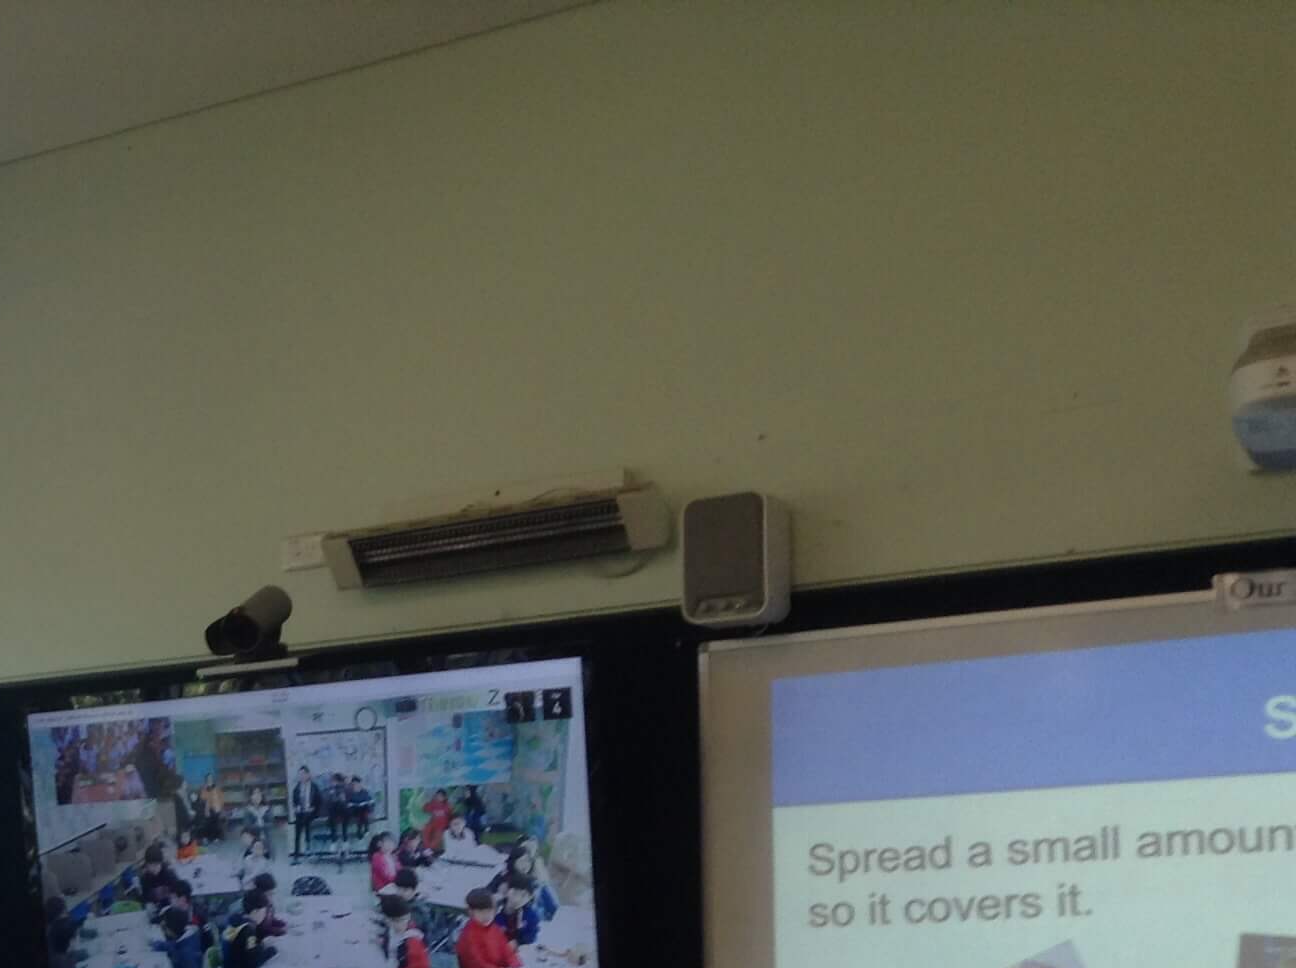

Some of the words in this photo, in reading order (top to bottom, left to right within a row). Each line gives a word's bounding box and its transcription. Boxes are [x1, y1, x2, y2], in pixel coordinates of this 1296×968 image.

[1229, 577, 1286, 600] Our
[808, 836, 954, 883] Spread
[967, 842, 994, 868] a
[1007, 824, 1121, 867] small
[1135, 823, 1296, 860] amoun
[808, 902, 856, 929] so
[868, 891, 892, 927] it
[904, 890, 1044, 925] covers
[1057, 882, 1094, 919] it.
